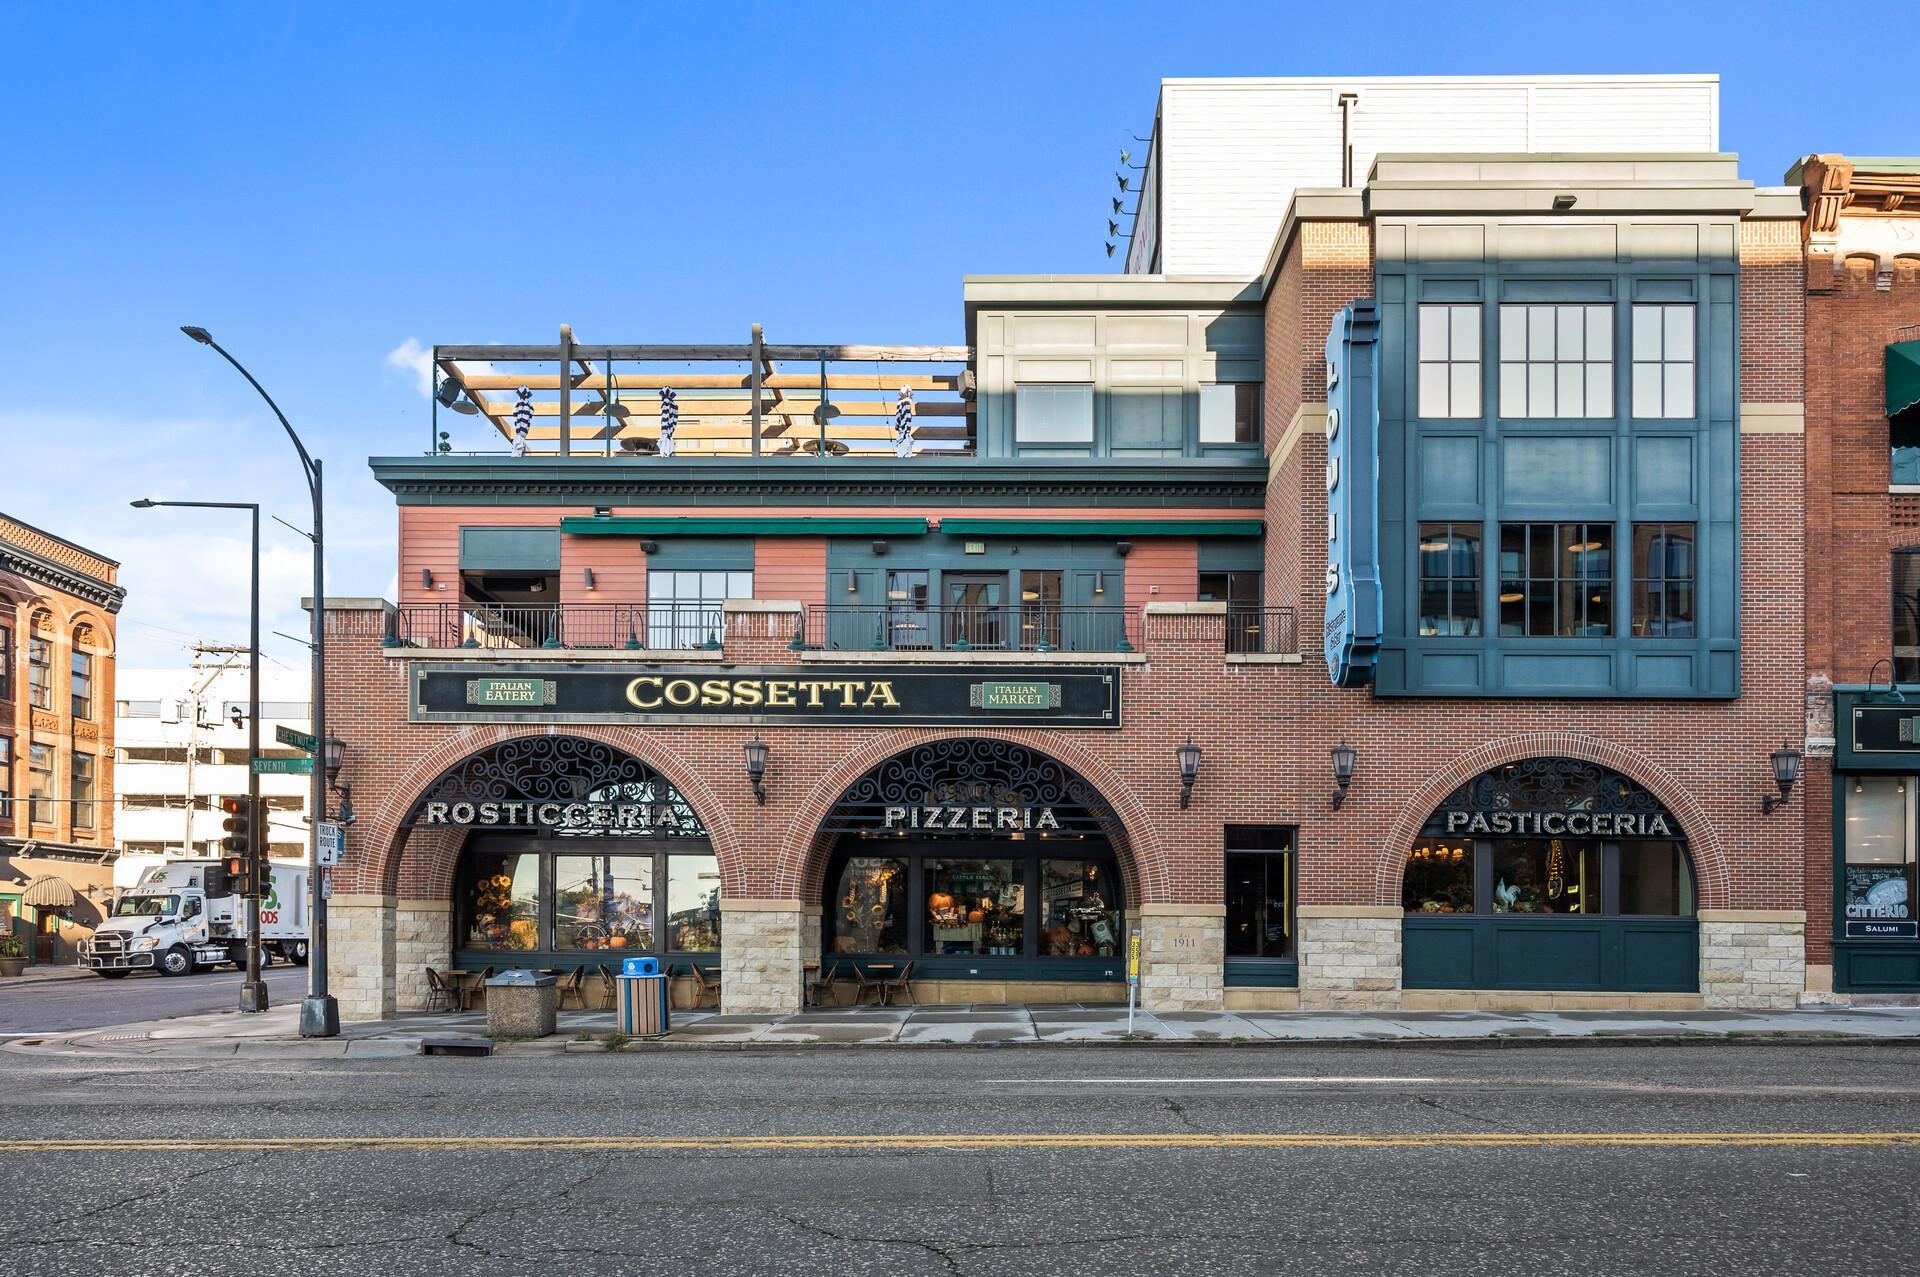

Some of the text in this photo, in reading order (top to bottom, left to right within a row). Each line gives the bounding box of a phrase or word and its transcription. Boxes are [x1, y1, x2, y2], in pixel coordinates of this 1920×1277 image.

[490, 682, 532, 690] ITALIAN
[994, 686, 1037, 694] ITALIAN
[485, 691, 536, 701] EATERY
[626, 676, 900, 709] COSSETTA
[988, 694, 1043, 704] MARKET
[277, 728, 309, 747] CHESTNUT
[253, 761, 286, 771] SEVENTH
[427, 802, 680, 827] ROSTICCERIA
[884, 806, 1061, 829] PIZZERIA
[1446, 811, 1672, 836] PASTICCERIA
[320, 824, 335, 836] TRUCK
[320, 837, 335, 848] ROUTE
[259, 911, 278, 924] ODS
[1173, 938, 1194, 947] 1911
